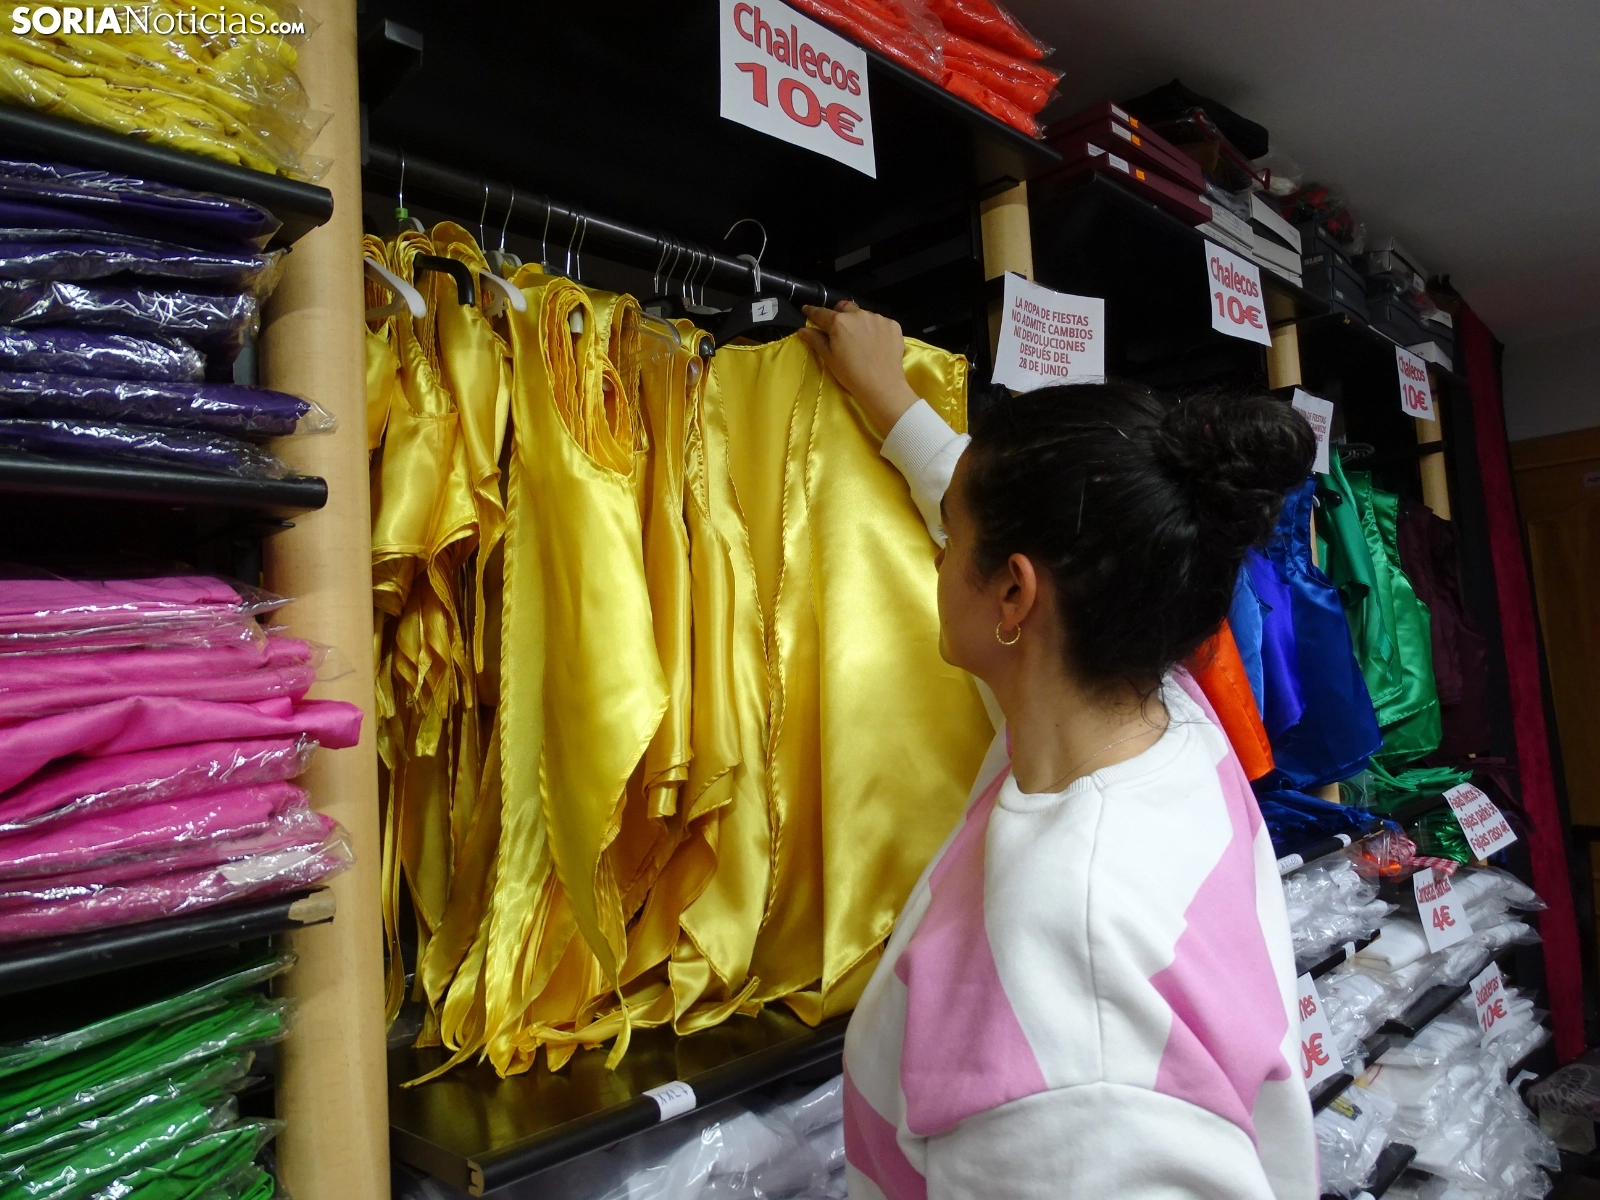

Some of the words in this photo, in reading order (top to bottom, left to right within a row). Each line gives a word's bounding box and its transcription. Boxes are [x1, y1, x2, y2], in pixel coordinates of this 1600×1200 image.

[734, 2, 861, 96] Chalecos
[735, 62, 864, 146] 10€
[1210, 257, 1259, 297] Chalecos
[1011, 309, 1021, 322] NO
[1022, 314, 1046, 333] ADMITE
[1048, 324, 1093, 340] CAMBIOS
[1015, 296, 1022, 309] LA
[1024, 300, 1039, 317] ROPA
[1041, 308, 1050, 320] DE
[1053, 311, 1089, 326] FIESTAS
[1214, 292, 1263, 329] 10€
[1014, 325, 1022, 338] NI
[1022, 330, 1086, 352] DEVOLUCIONES
[1019, 357, 1027, 369] 28
[1029, 360, 1039, 372] DE
[1040, 363, 1068, 377] JUNIO
[1020, 343, 1051, 361] DESPUÉS
[1054, 352, 1071, 364] DEL
[1399, 356, 1425, 382] Chalecos
[1402, 383, 1428, 411] 10€
[1459, 813, 1479, 832] Fajas
[1470, 833, 1491, 852] Fajas
[1487, 826, 1503, 842] raso
[1432, 905, 1455, 931] 4€
[1481, 998, 1508, 1032] 10€
[1301, 1033, 1330, 1078] 0€
